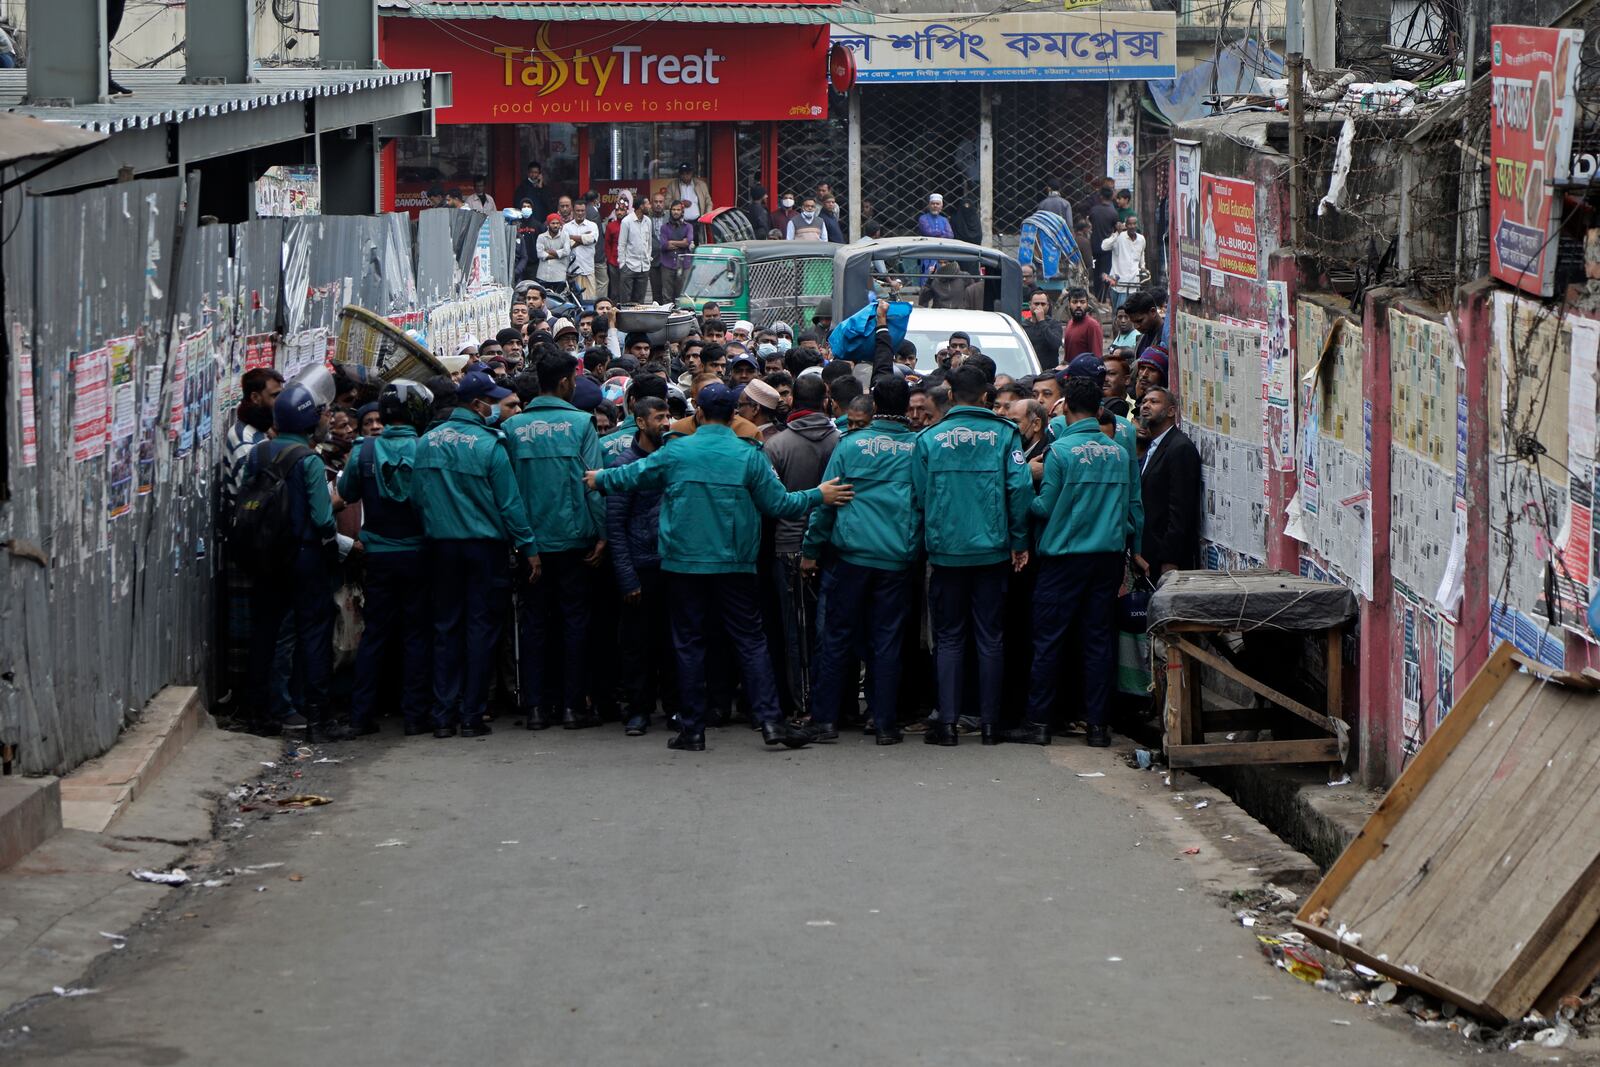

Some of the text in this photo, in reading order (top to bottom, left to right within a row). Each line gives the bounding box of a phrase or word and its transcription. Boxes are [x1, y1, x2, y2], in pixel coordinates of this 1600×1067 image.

[888, 24, 991, 62] শপিং
[1000, 29, 1165, 61] কমপ্লেক্স
[493, 98, 719, 116] food you'll love to share!
[395, 198, 433, 207] SANDWIC
[1218, 198, 1230, 215] Moral
[1218, 235, 1256, 252] AL-BUROOJ
[428, 428, 478, 449] পুলিশ
[515, 420, 572, 443] পুলিশ
[935, 426, 997, 449] পুলিশ
[604, 434, 634, 455] পুলি
[855, 435, 915, 457] পুলিশ
[1070, 441, 1121, 465] পুলিশ
